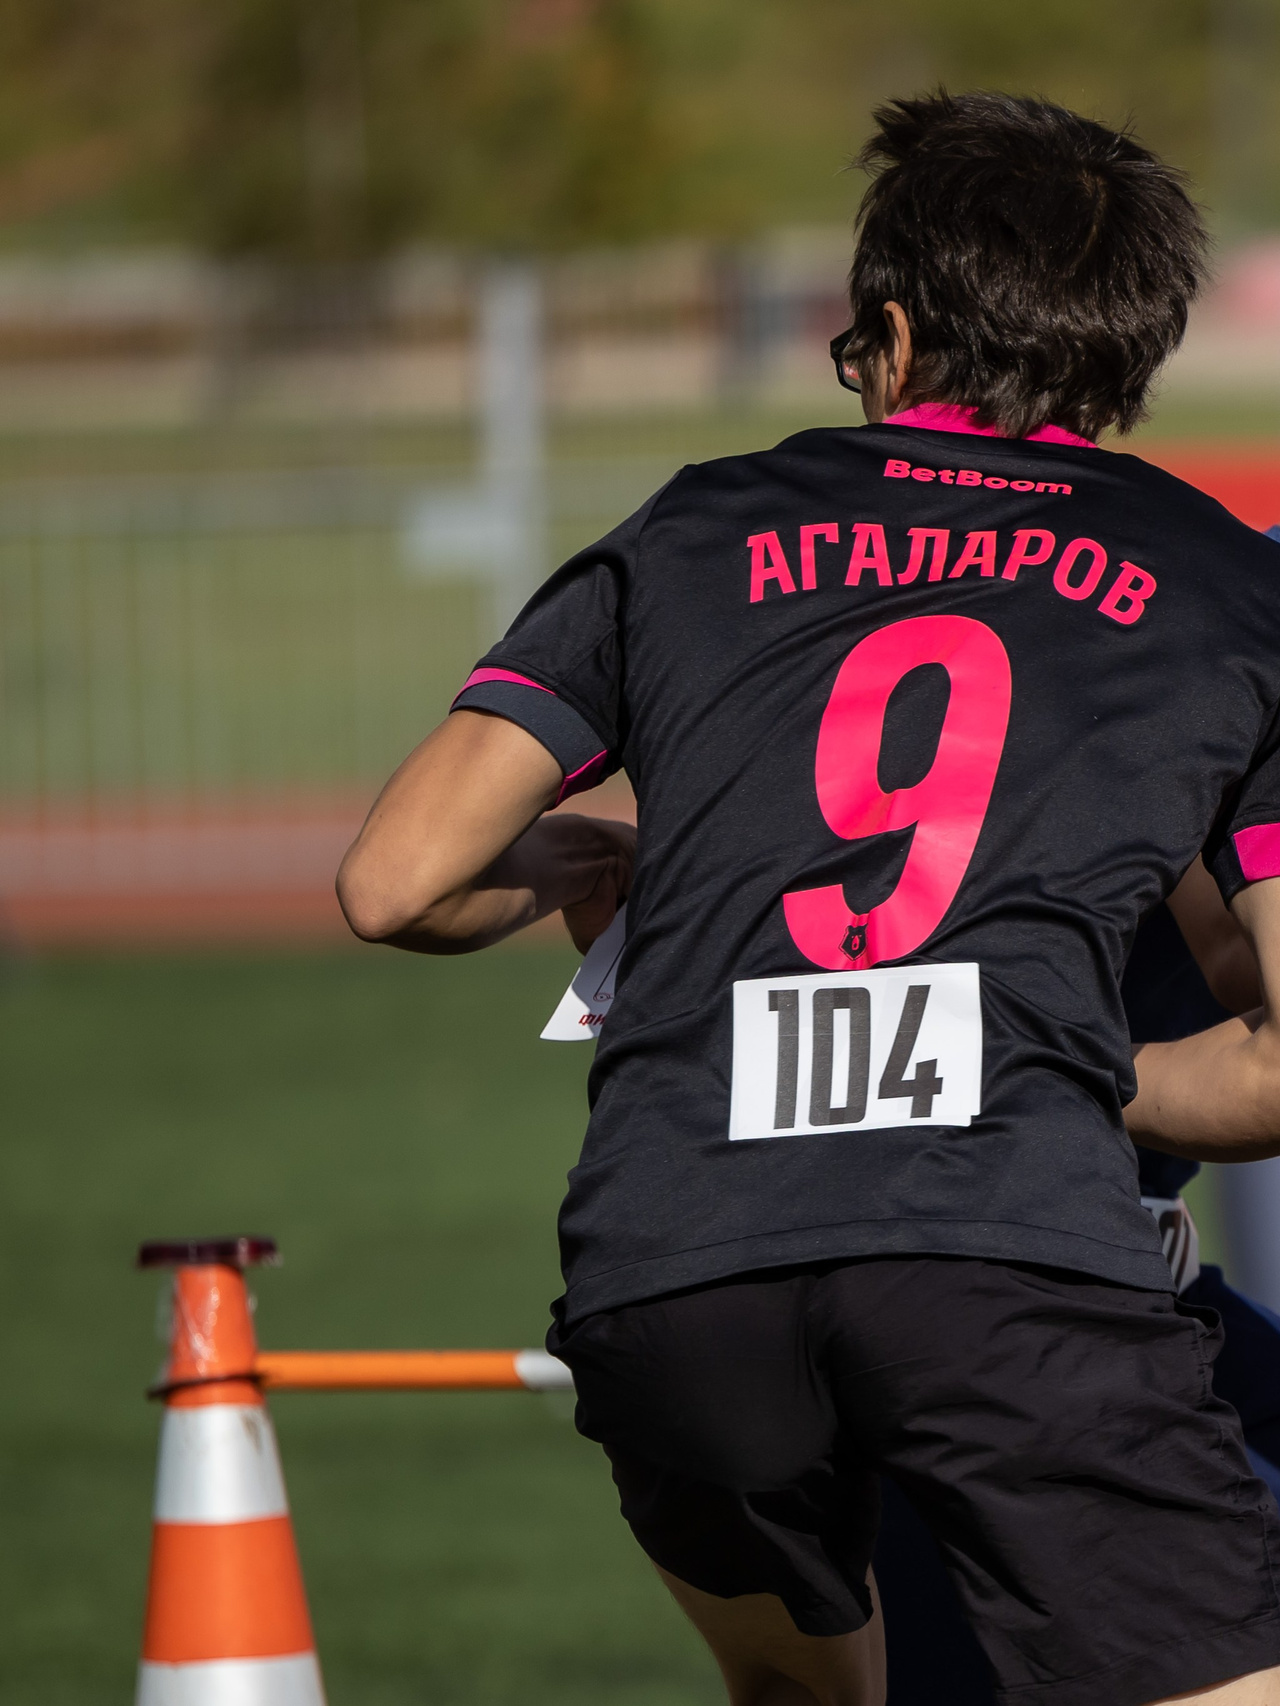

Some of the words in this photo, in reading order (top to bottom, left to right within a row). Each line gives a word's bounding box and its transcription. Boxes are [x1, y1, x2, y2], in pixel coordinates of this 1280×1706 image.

[883, 458, 1073, 496] BetBoom
[746, 522, 1157, 625] АГАЛАРОВ
[782, 614, 1012, 971] 9
[768, 984, 944, 1130] 104
